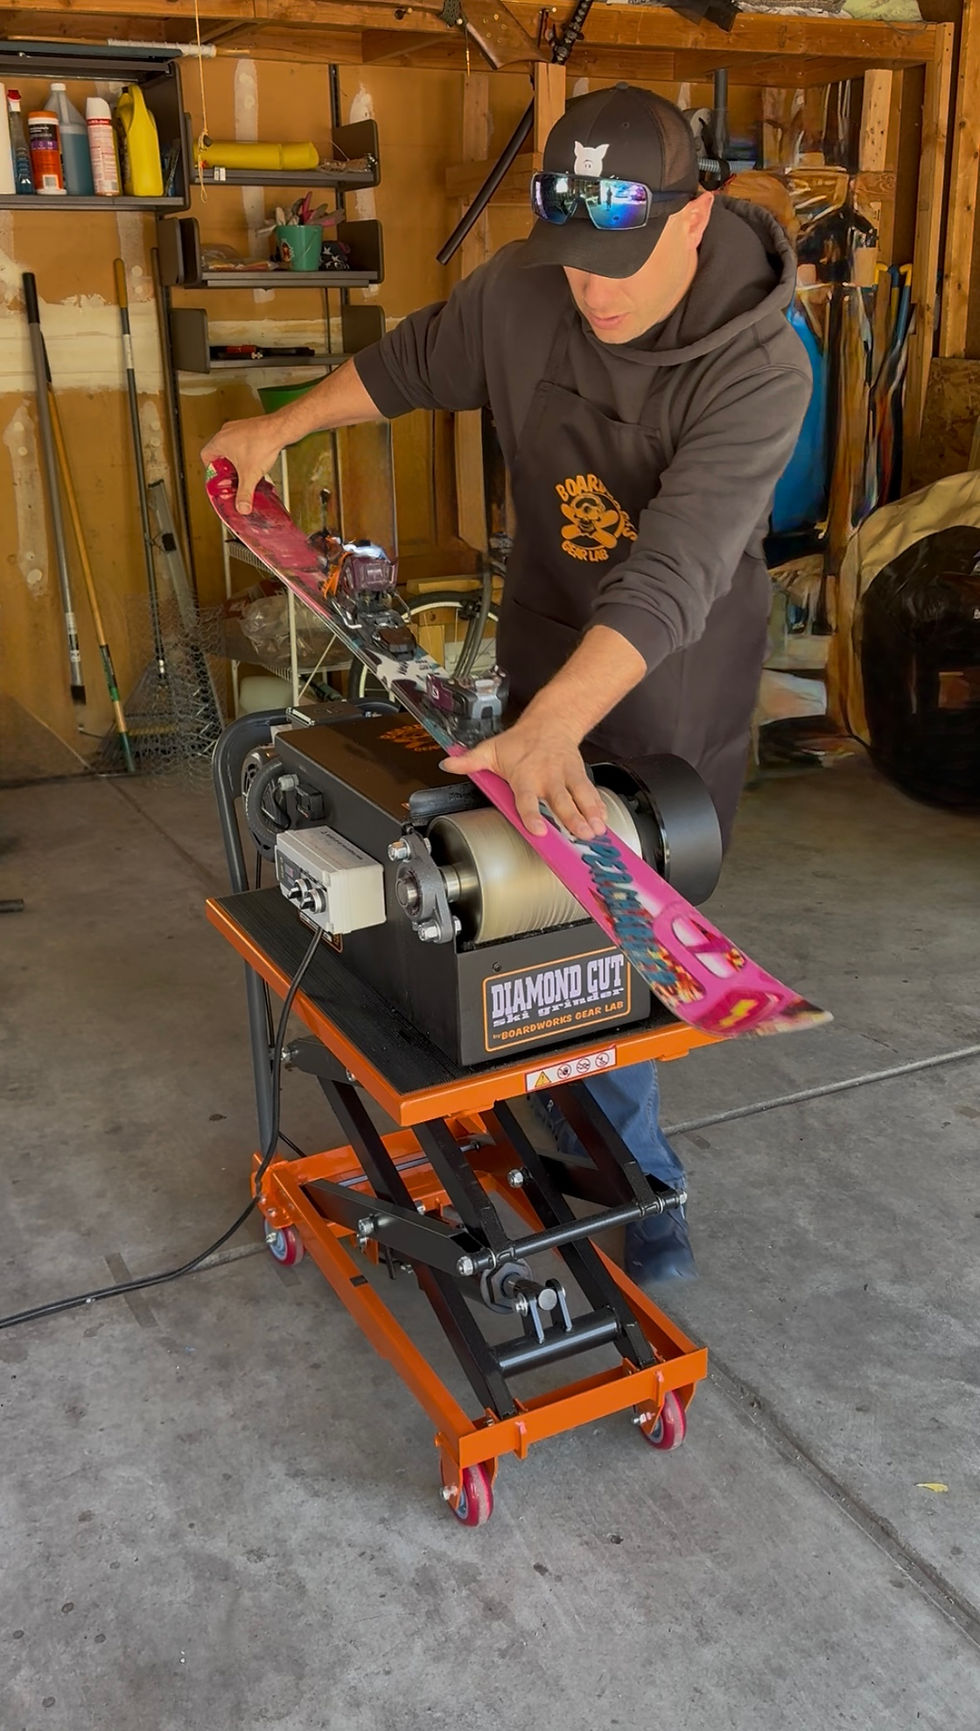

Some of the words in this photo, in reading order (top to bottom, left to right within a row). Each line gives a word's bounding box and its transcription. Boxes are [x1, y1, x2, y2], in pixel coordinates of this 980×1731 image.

[588, 549, 609, 562] LAB
[491, 964, 582, 1019] DIAMOND
[587, 953, 625, 994] CUT
[493, 1010, 530, 1028] ski
[538, 987, 625, 1017] grinder
[501, 1014, 572, 1040] BOARDWORKS
[575, 1006, 602, 1021] GEAR
[604, 1000, 624, 1012] LAB
